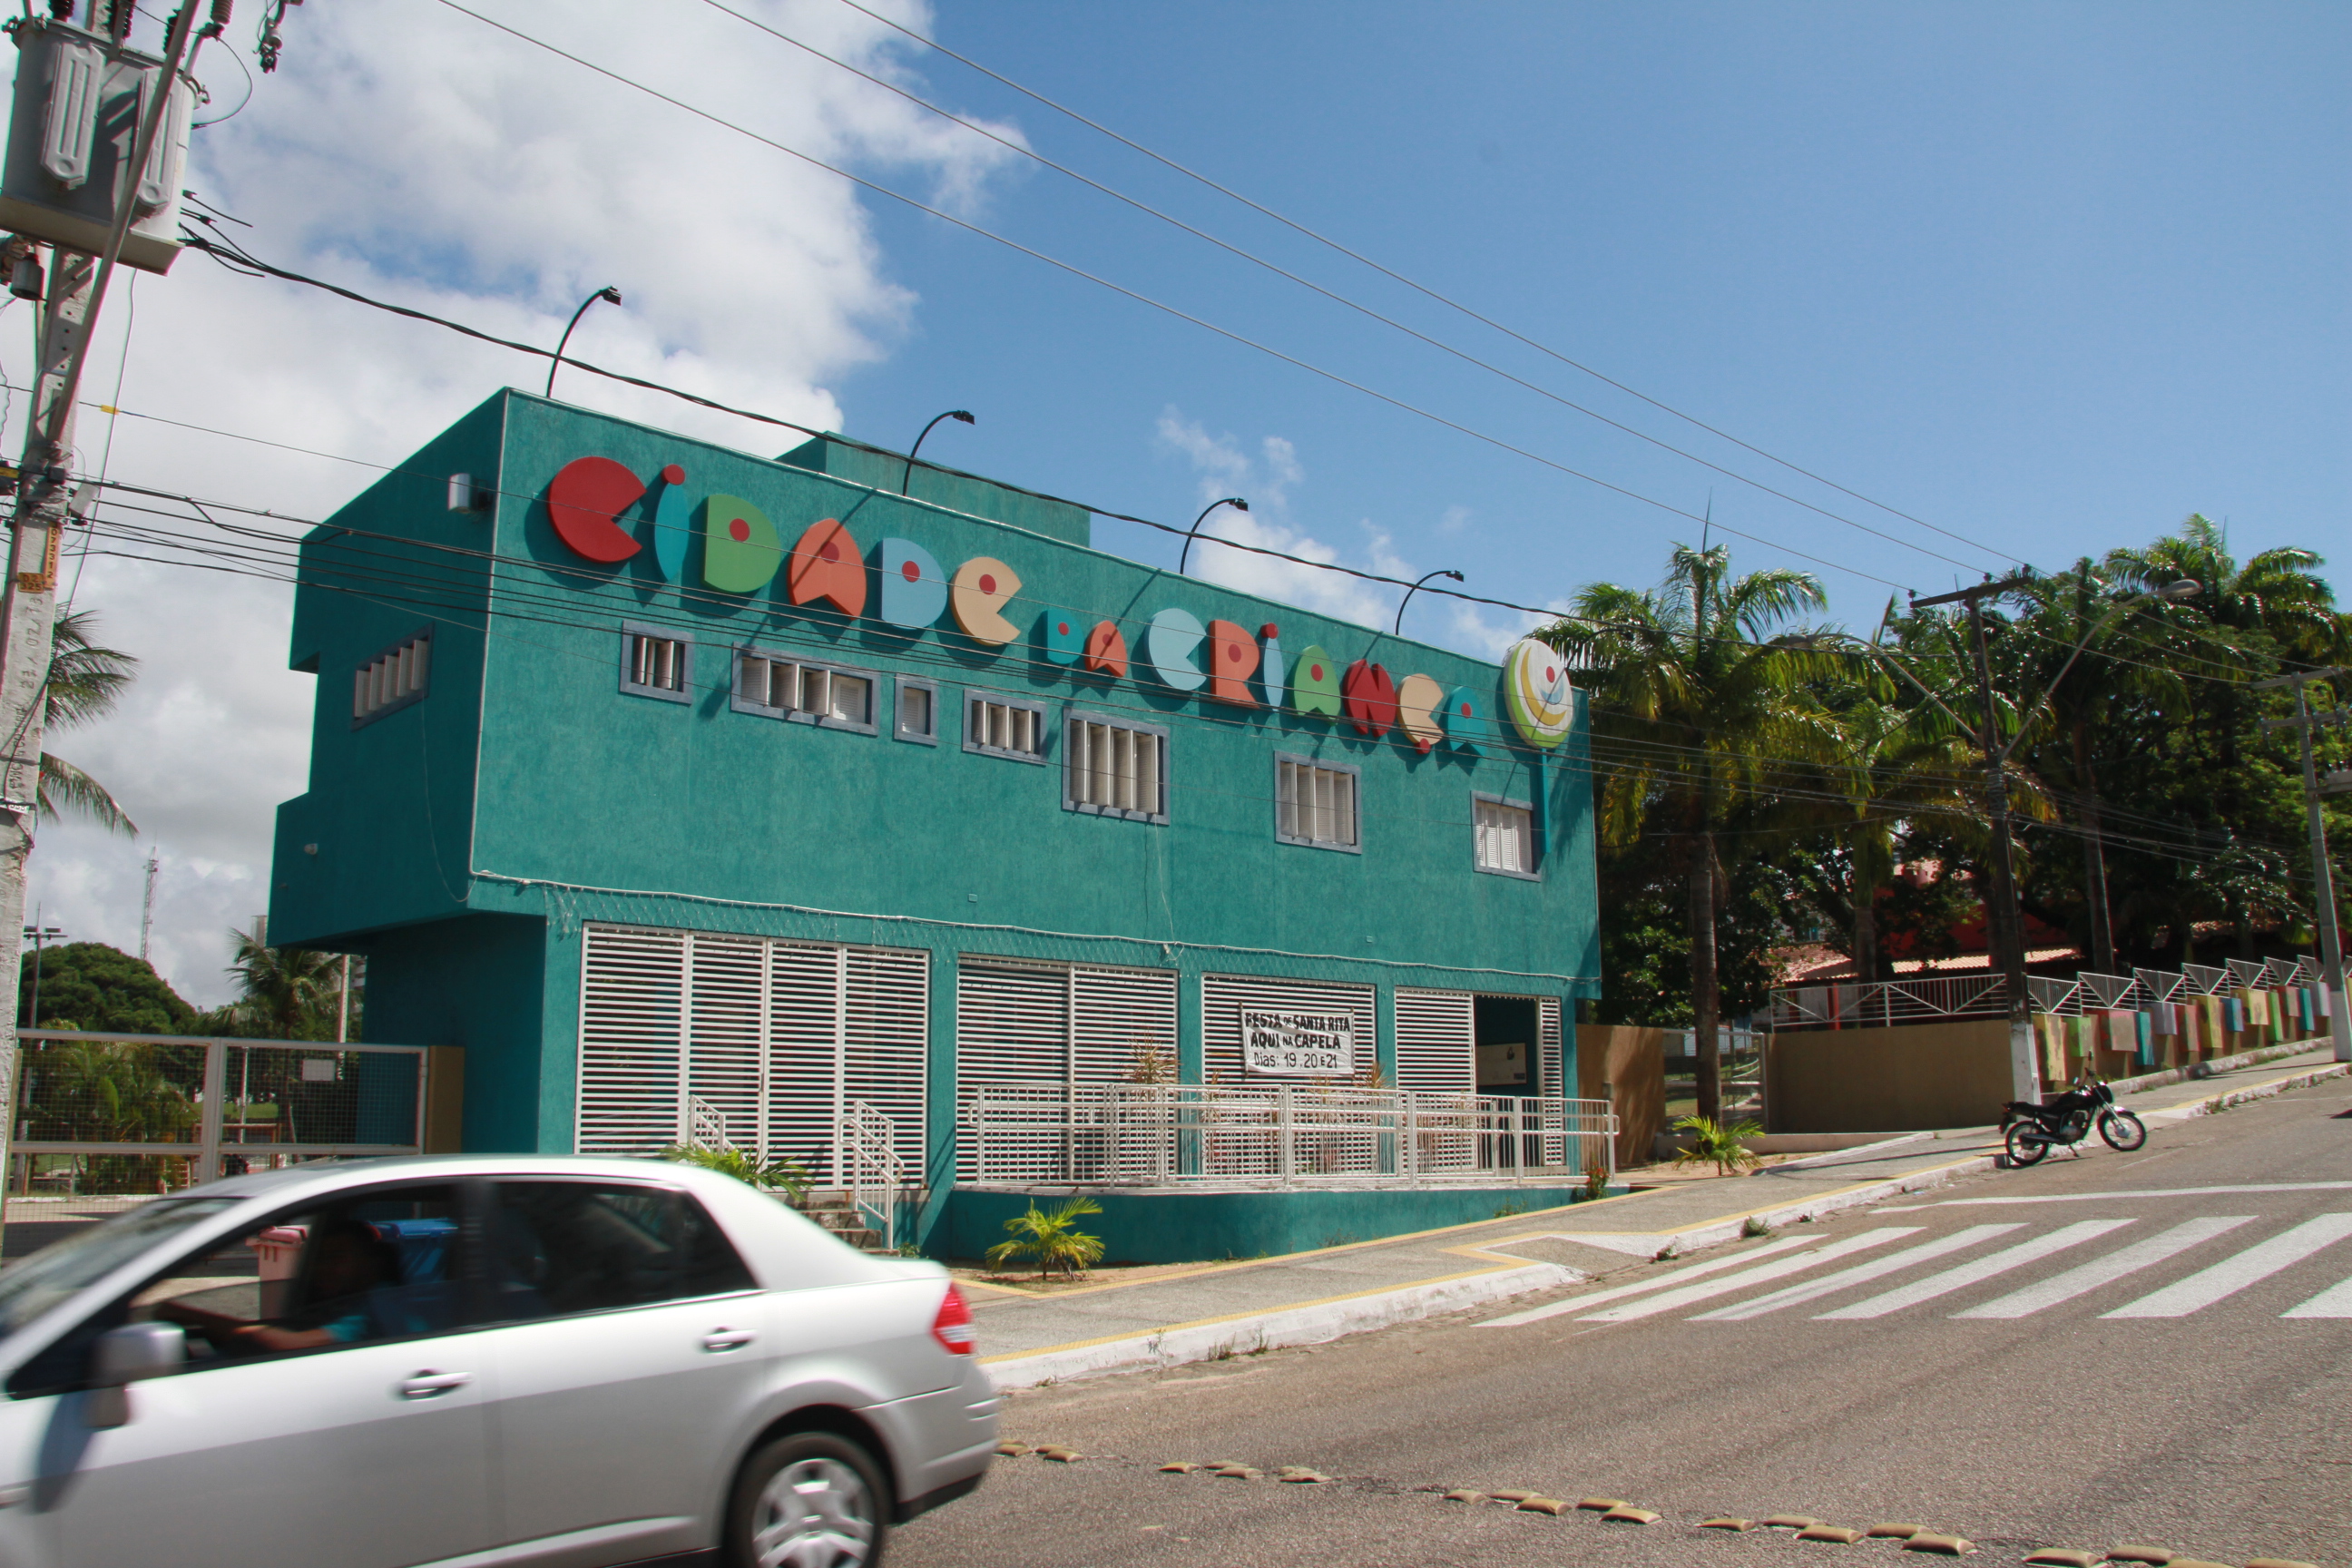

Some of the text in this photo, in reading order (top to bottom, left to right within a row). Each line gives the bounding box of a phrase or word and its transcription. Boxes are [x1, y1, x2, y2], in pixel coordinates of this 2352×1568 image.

[1045, 607, 1128, 678] DA
[1245, 1012, 1350, 1032] FESTA DE SANTA RITA
[1250, 1032, 1341, 1049] AQUI NA CAPELA
[1254, 1052, 1280, 1067] Dias:
[1326, 1053, 1338, 1069] 21
